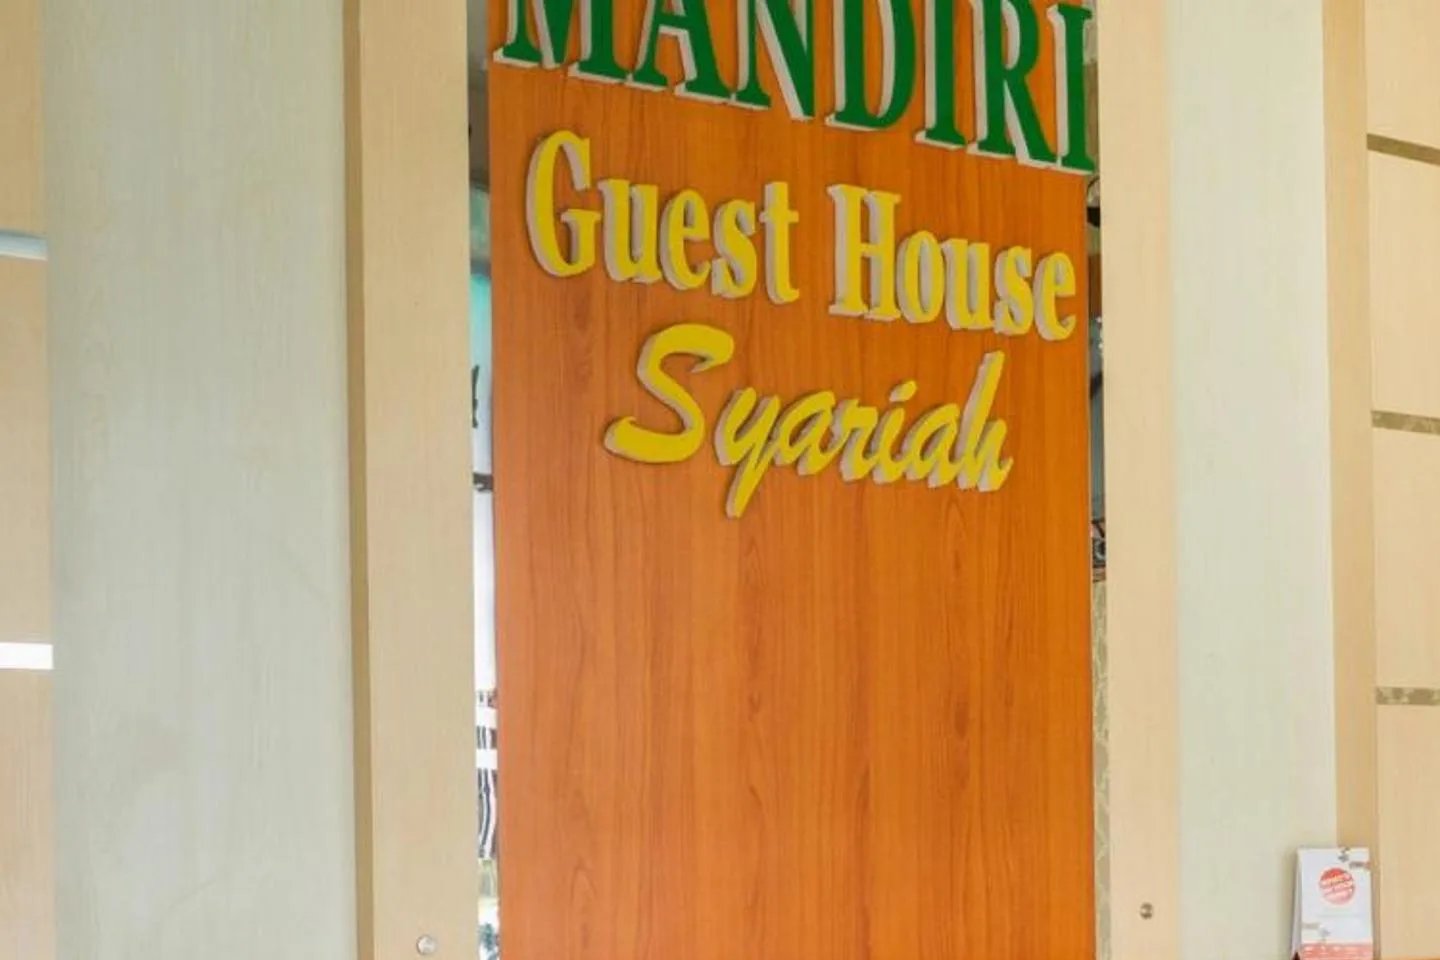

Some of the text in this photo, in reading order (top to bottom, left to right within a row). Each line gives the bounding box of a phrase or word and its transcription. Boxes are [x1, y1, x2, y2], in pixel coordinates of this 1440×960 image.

[526, 130, 1077, 340] Guest House
[604, 323, 1014, 518] Syariah
